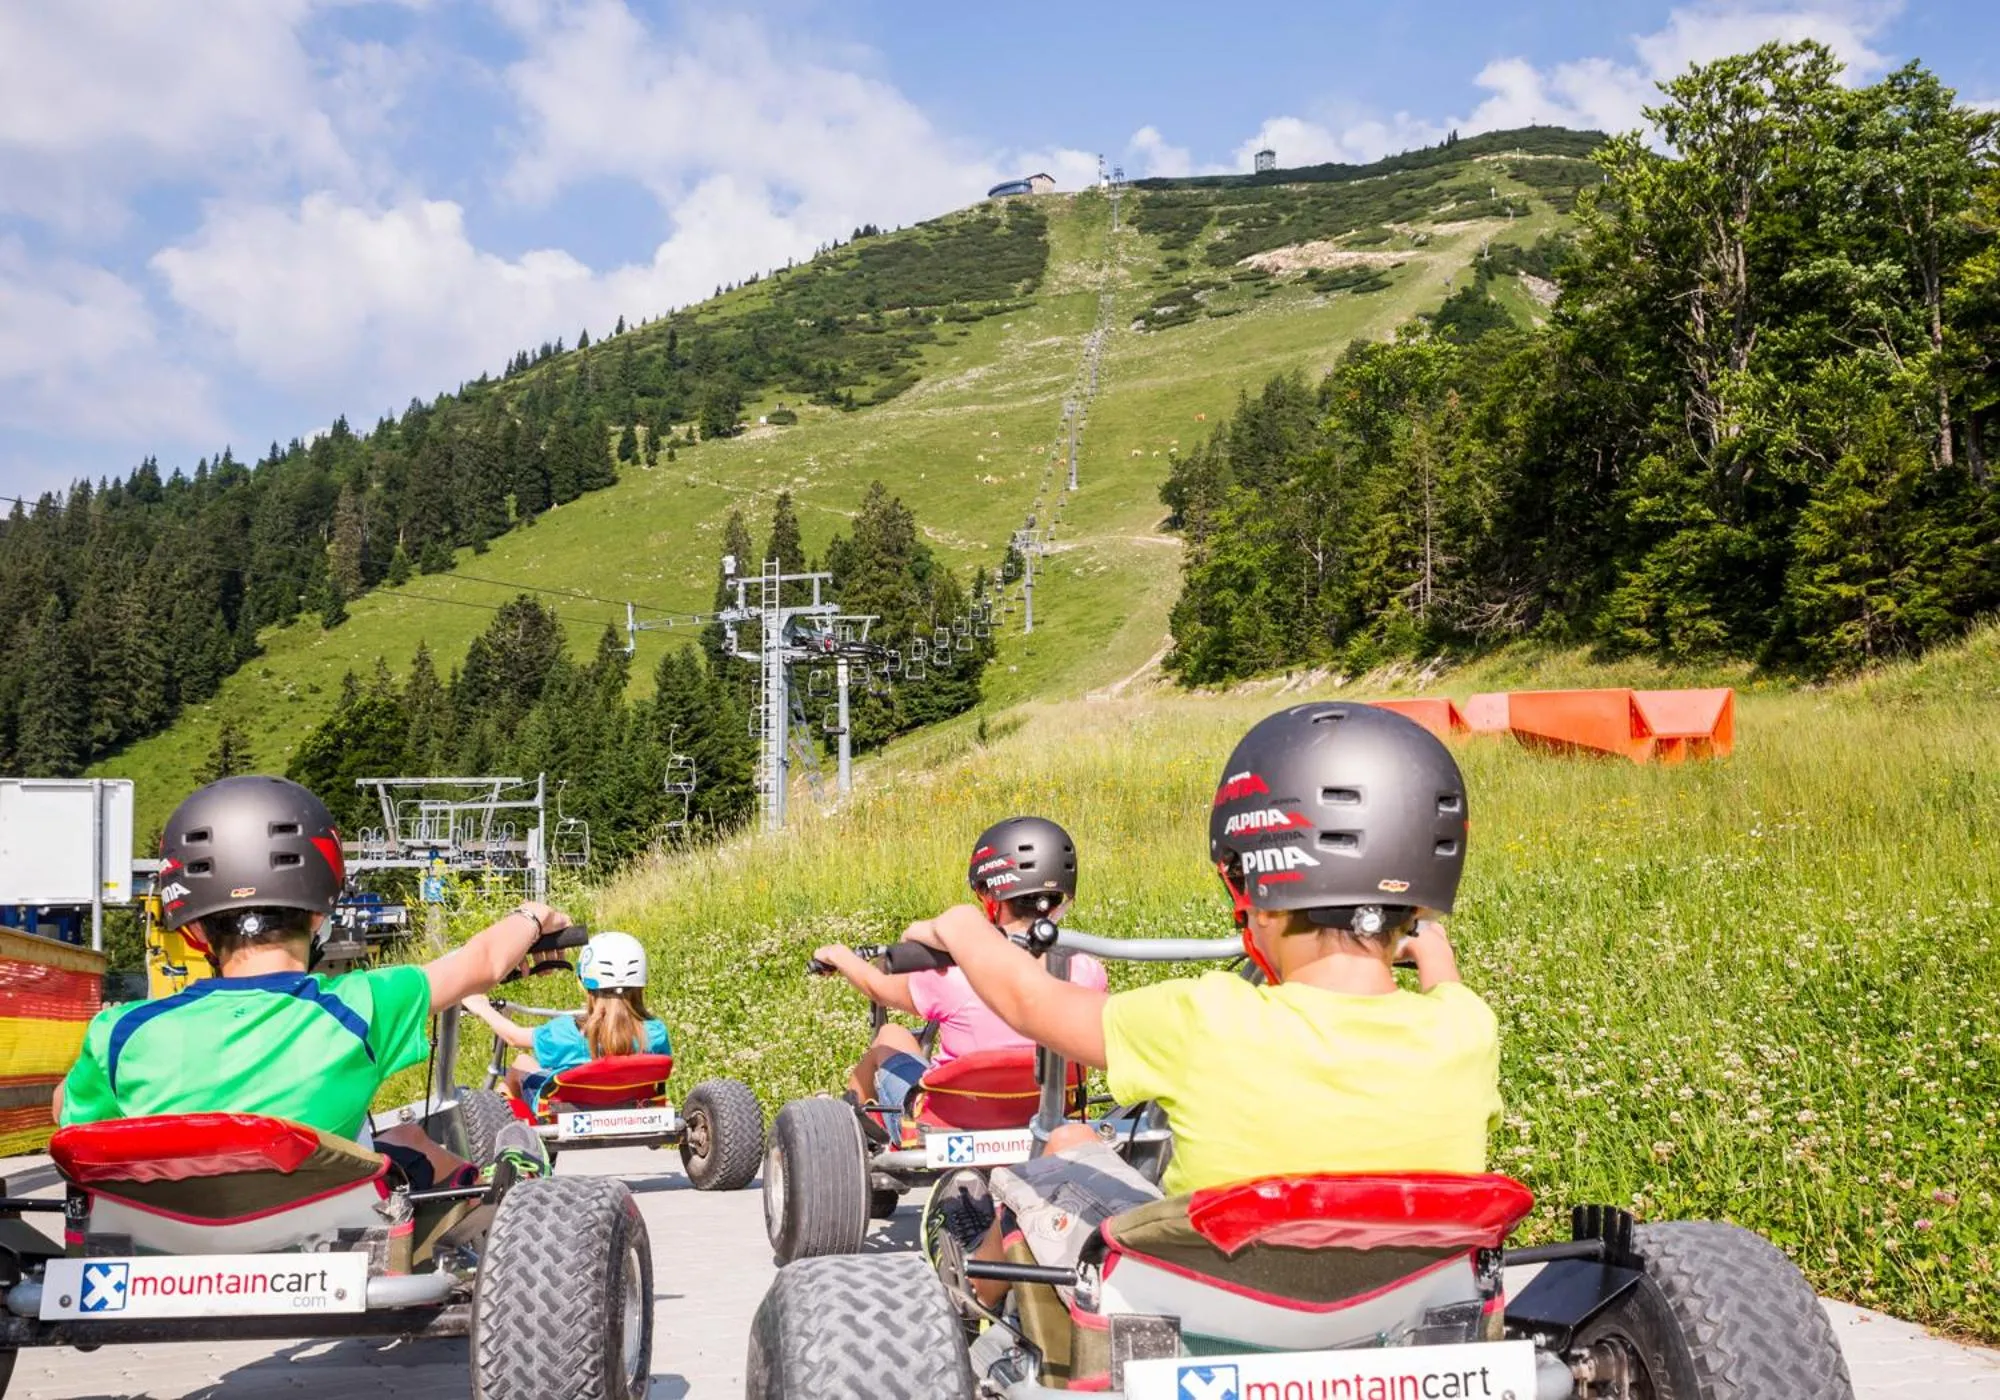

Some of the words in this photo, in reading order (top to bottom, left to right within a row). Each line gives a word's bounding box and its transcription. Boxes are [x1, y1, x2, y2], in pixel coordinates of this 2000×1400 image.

[1224, 808, 1292, 835] ALPINA
[1241, 846, 1320, 875] PINA
[593, 1115, 662, 1128] mountaincart
[131, 1269, 328, 1296] mountaincart
[292, 1294, 327, 1308] com
[1246, 1366, 1492, 1400] mountaincart
